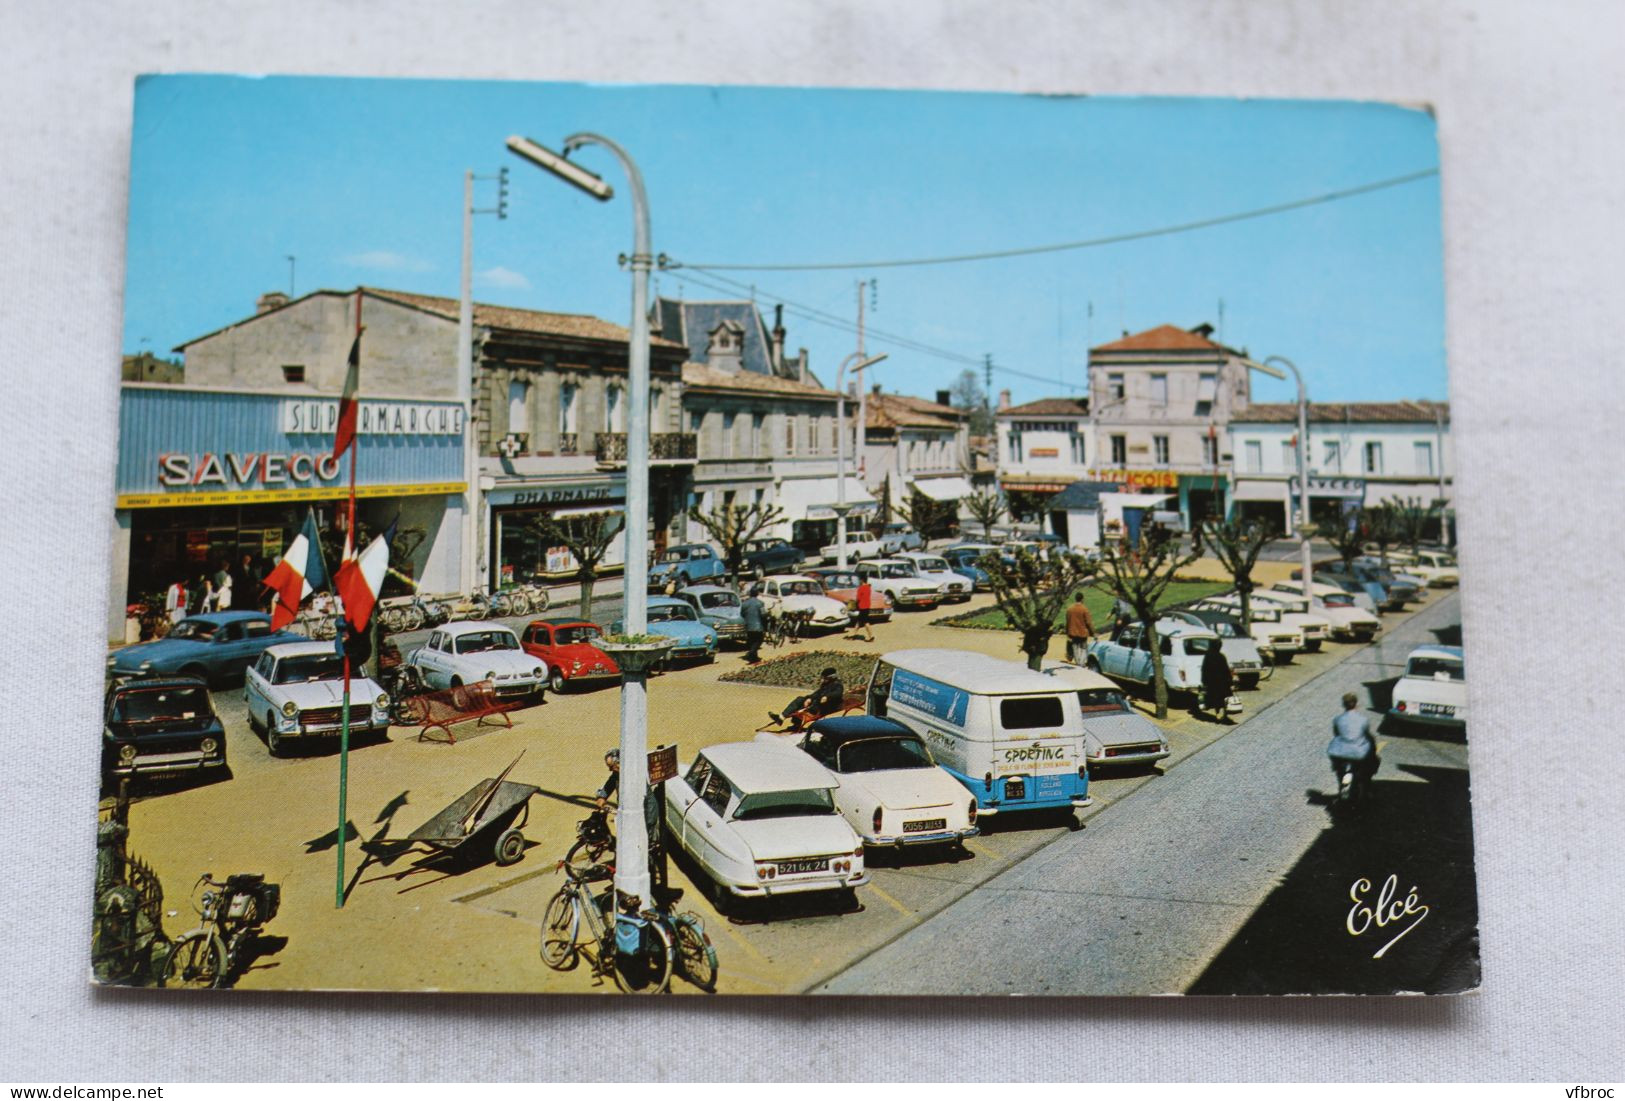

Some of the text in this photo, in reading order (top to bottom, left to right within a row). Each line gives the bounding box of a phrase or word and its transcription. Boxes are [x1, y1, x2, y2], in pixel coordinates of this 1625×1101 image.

[292, 404, 463, 433] SUPRMARCHE
[159, 453, 340, 485] SAVECO
[514, 487, 611, 504] PHARMACIE
[1005, 747, 1064, 763] SPORTING
[780, 863, 797, 874] 521
[815, 860, 827, 871] 24
[1347, 874, 1428, 958] Elcé
